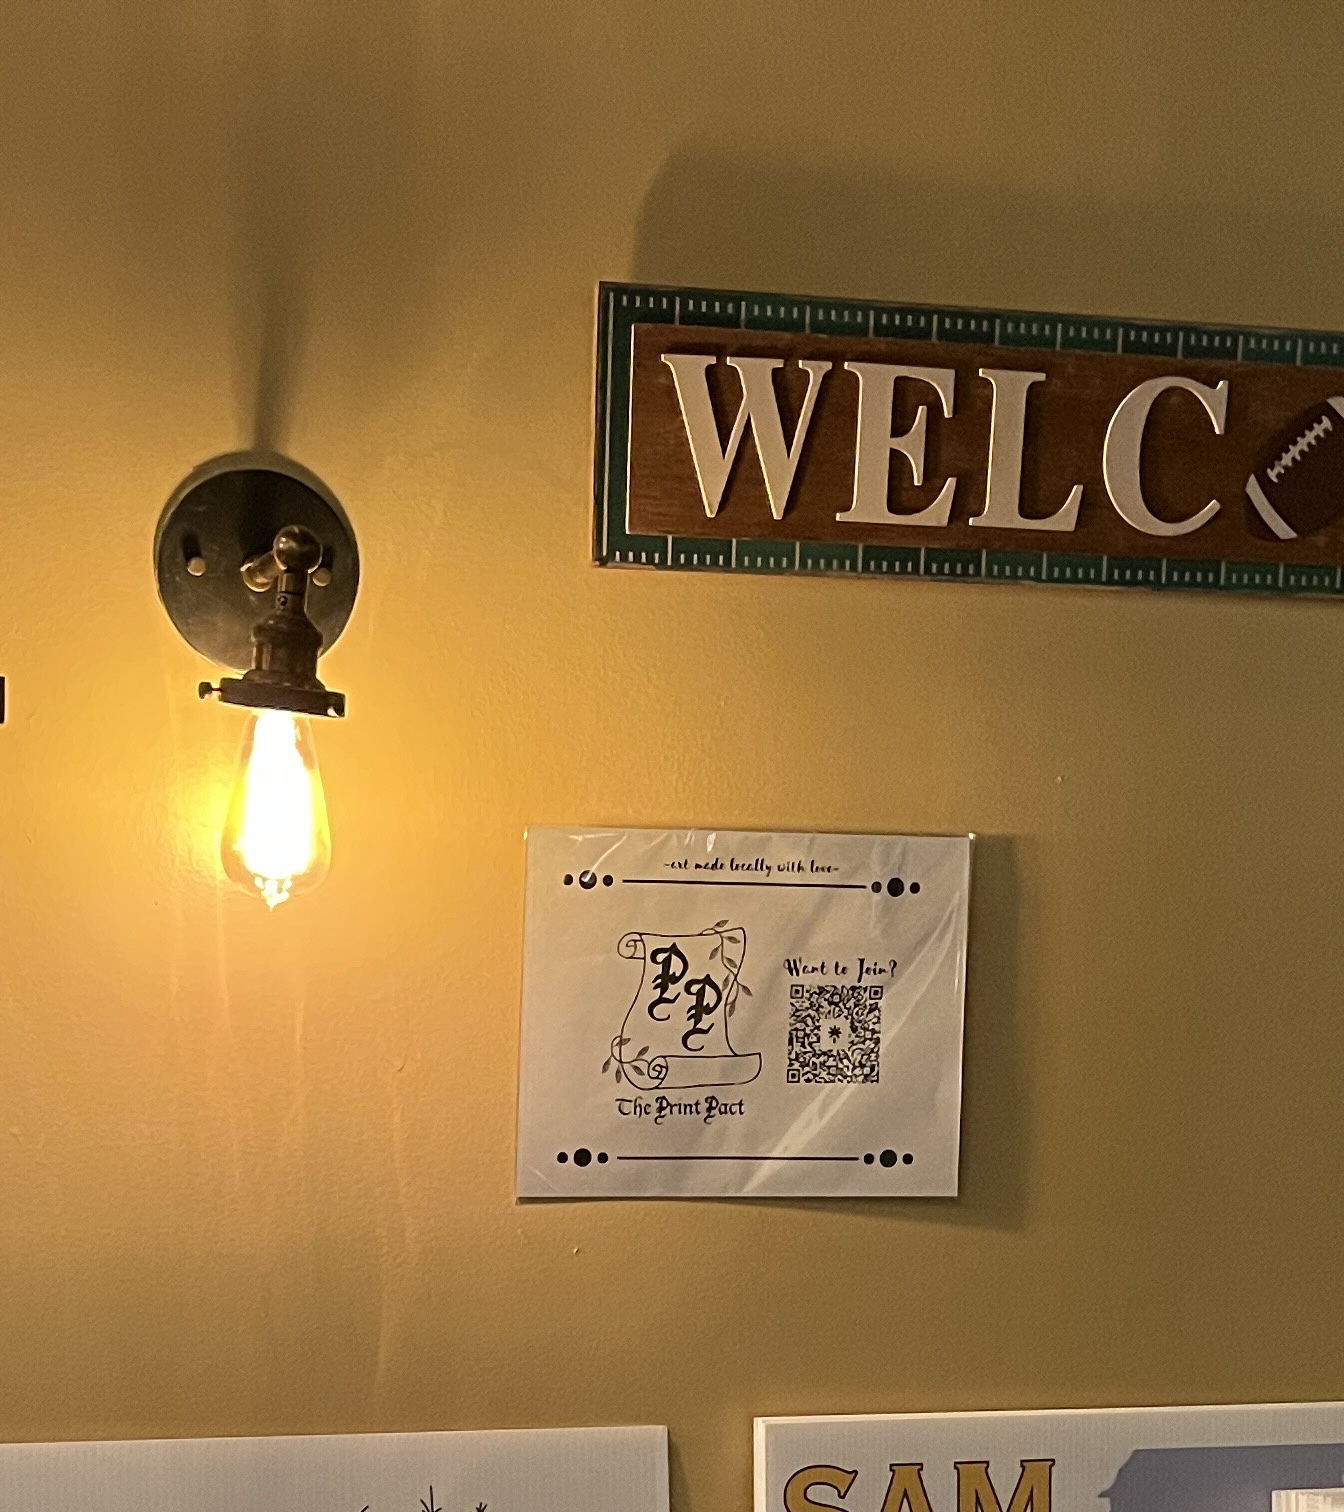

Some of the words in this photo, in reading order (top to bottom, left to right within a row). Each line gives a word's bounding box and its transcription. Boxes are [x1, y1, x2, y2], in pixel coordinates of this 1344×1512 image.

[693, 858, 725, 870] made
[730, 858, 772, 877] locally
[777, 859, 805, 872] with
[783, 958, 828, 977] Want
[834, 960, 849, 976] to
[856, 958, 898, 983] Join?
[616, 1098, 652, 1118] The
[654, 1096, 701, 1124] Print
[704, 1096, 745, 1124] Pact
